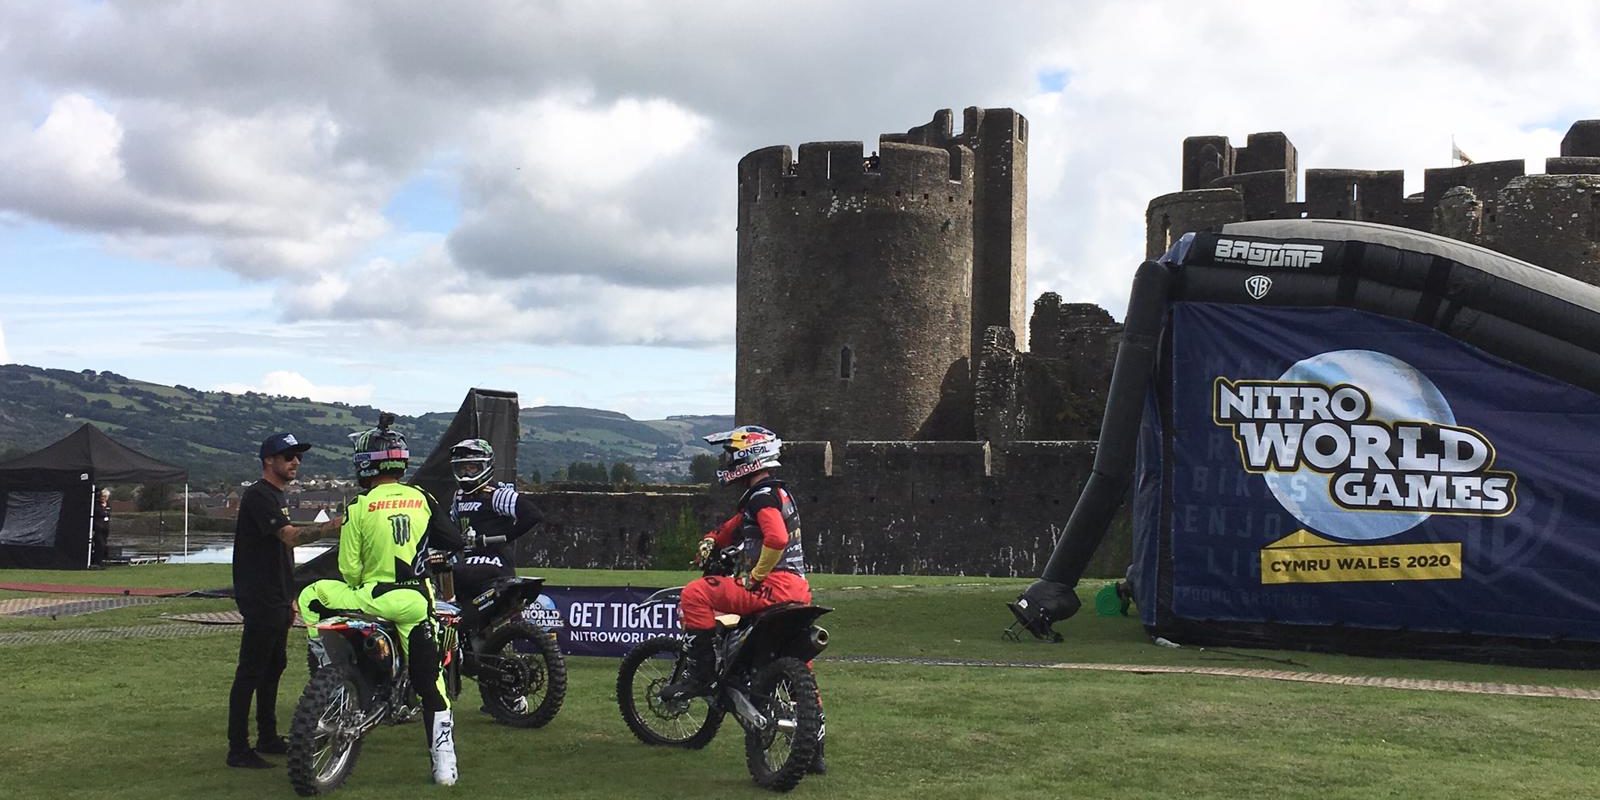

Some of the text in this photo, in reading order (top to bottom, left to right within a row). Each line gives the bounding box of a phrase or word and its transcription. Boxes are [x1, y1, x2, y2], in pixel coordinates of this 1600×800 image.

[1220, 383, 1367, 422] NITRO
[1240, 422, 1488, 473] WORLD
[722, 459, 762, 481] Red Bull
[1335, 472, 1510, 511] GAMES
[368, 499, 423, 512] SHEEHAN
[458, 502, 482, 512] THOR
[1270, 555, 1451, 572] CYMRU WALES 2020
[521, 610, 560, 619] WORLD
[536, 619, 564, 627] GAMES
[569, 602, 605, 628] GET
